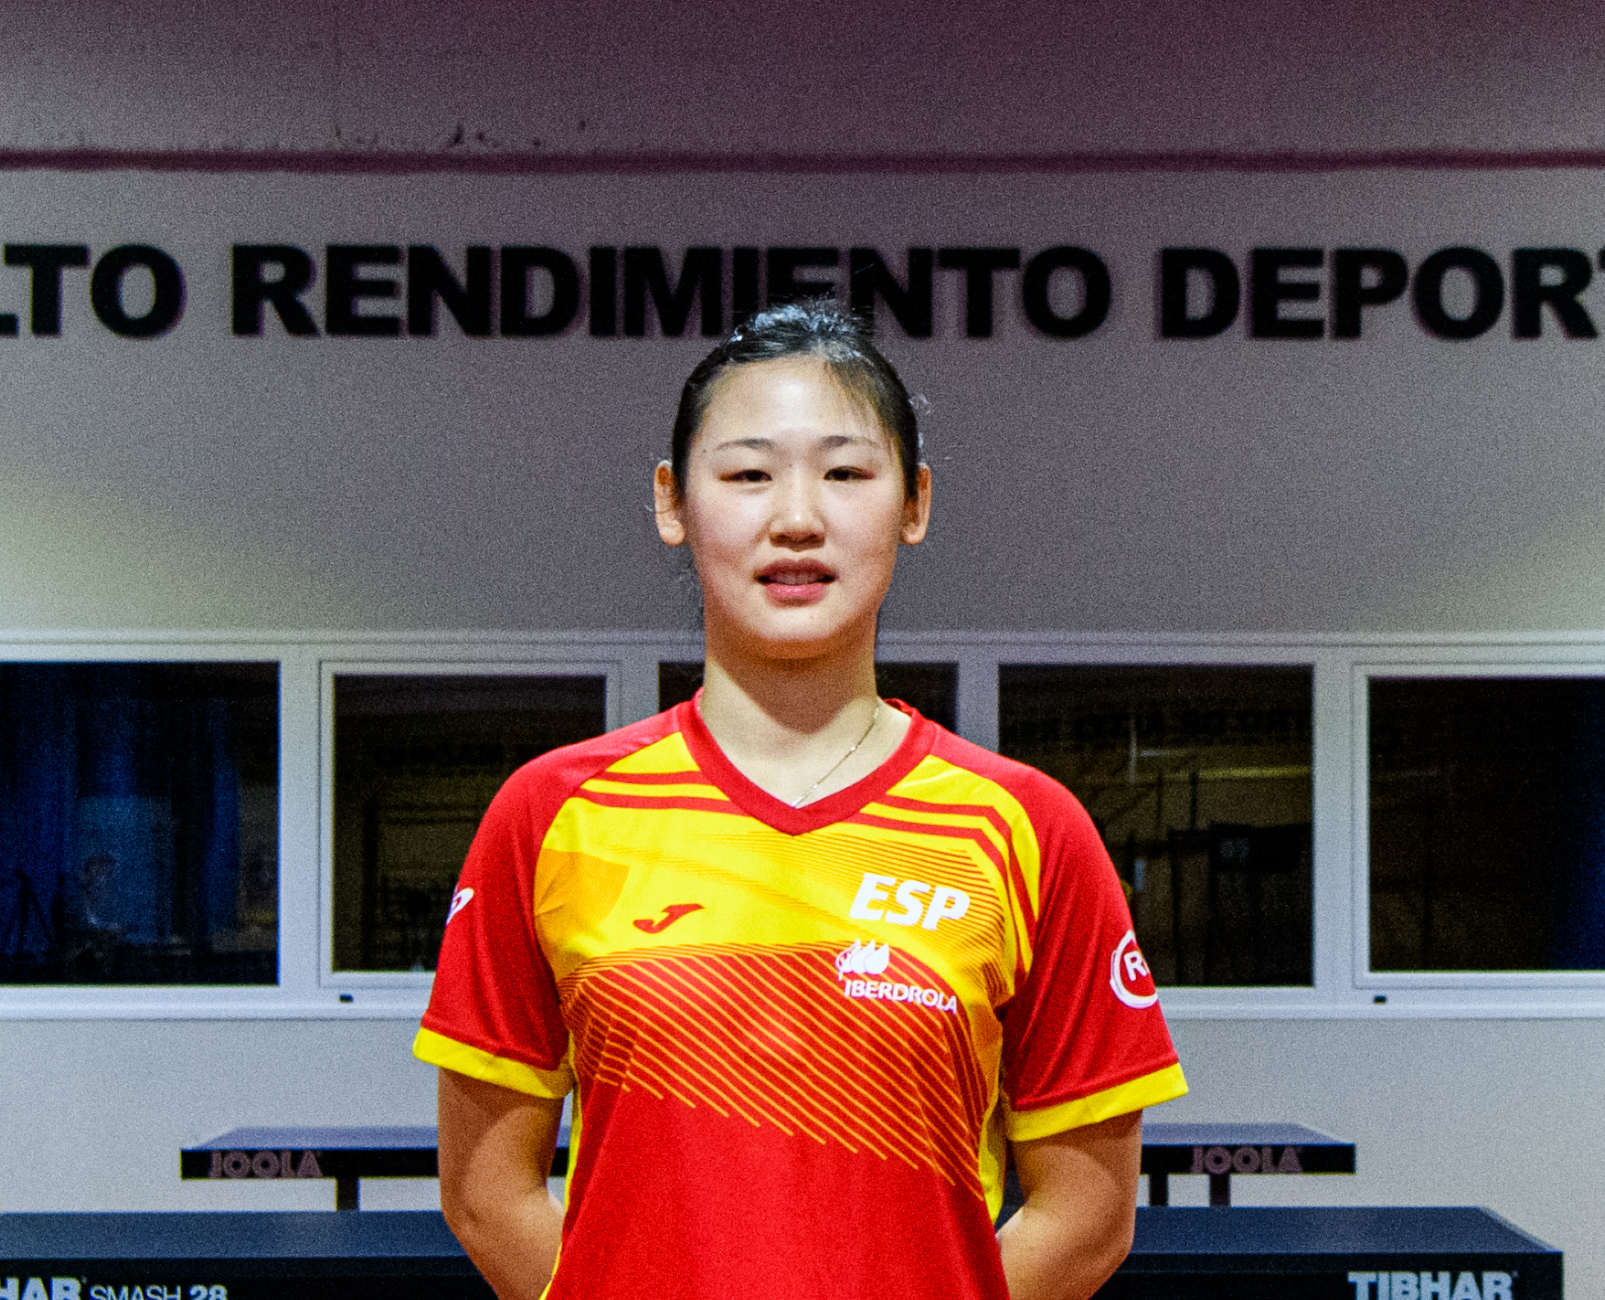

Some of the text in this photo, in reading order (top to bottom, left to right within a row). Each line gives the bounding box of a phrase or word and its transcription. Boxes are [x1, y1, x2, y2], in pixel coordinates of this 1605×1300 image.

[231, 244, 1115, 340] RENDIMIENTO
[848, 872, 971, 931] ESP
[843, 979, 958, 1015] IBERDROLA
[208, 1149, 323, 1179] JOOLA
[1189, 1144, 1304, 1175] JOOLA
